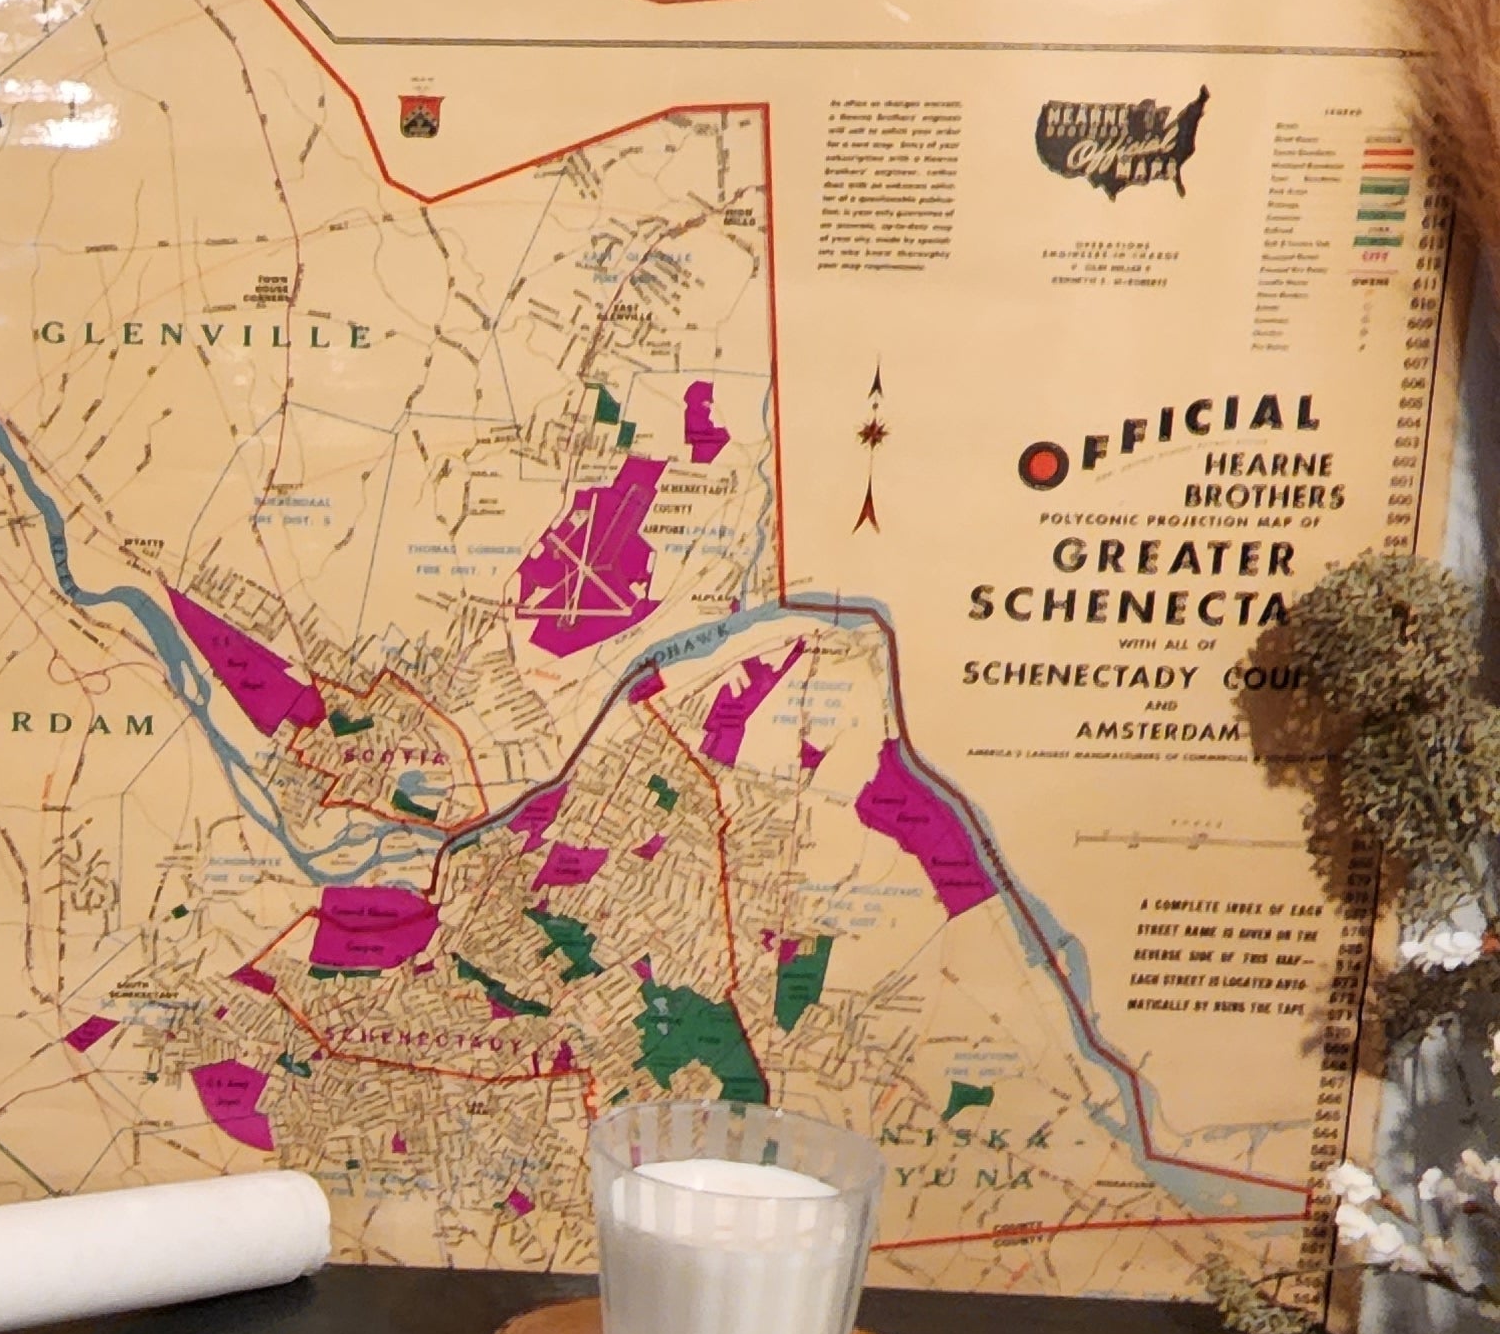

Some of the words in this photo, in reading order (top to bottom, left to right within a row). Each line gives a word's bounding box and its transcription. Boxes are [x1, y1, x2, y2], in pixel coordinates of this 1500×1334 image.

[1066, 121, 1180, 175] Official
[40, 321, 370, 349] GLENVILLE
[1018, 394, 1320, 491] OFFICIAL
[1204, 452, 1334, 477] HEARNE
[660, 484, 729, 496] SCHENECTADY
[1184, 484, 1346, 510] BROTHERS
[653, 503, 693, 515] COUNTY
[1039, 513, 1139, 527] POLYCONIC
[1146, 514, 1248, 528] PROJECTION
[1257, 515, 1292, 528] MAP
[1301, 516, 1322, 529] OF
[1052, 537, 1296, 576] GREATER
[967, 583, 1290, 627] SCHENECTA
[644, 622, 729, 664] OHAWK
[1118, 638, 1156, 650] WITH
[1163, 639, 1189, 651] ALL
[1197, 639, 1218, 651] OF
[962, 661, 1199, 690] SCHENECTADY
[1145, 700, 1178, 711] AND
[1076, 722, 1240, 741] AMSTERDAM
[1155, 899, 1220, 913] COMPLETE
[1225, 902, 1262, 915] INDEX
[1269, 903, 1285, 915] OF
[1290, 904, 1324, 917] EACH
[1137, 924, 1180, 936] STREET
[1184, 925, 1218, 937] NAME
[1239, 928, 1272, 940] GIVEN
[1297, 930, 1318, 942] THE
[1133, 948, 1182, 961] REVERSE
[1189, 950, 1214, 961] SIDE
[1220, 951, 1235, 962] OF
[1243, 953, 1268, 964] THIS
[1130, 973, 1159, 986] EACH
[1163, 974, 1206, 987] STREET
[1223, 975, 1273, 989] LOCATED
[1127, 998, 1190, 1011] MATICALLY
[1213, 1000, 1245, 1013] USING
[1250, 1002, 1272, 1014] THE
[325, 1027, 522, 1054] SCHENECTADY
[896, 1167, 1034, 1190] YUNA
[992, 1235, 1044, 1248] COUNTY
